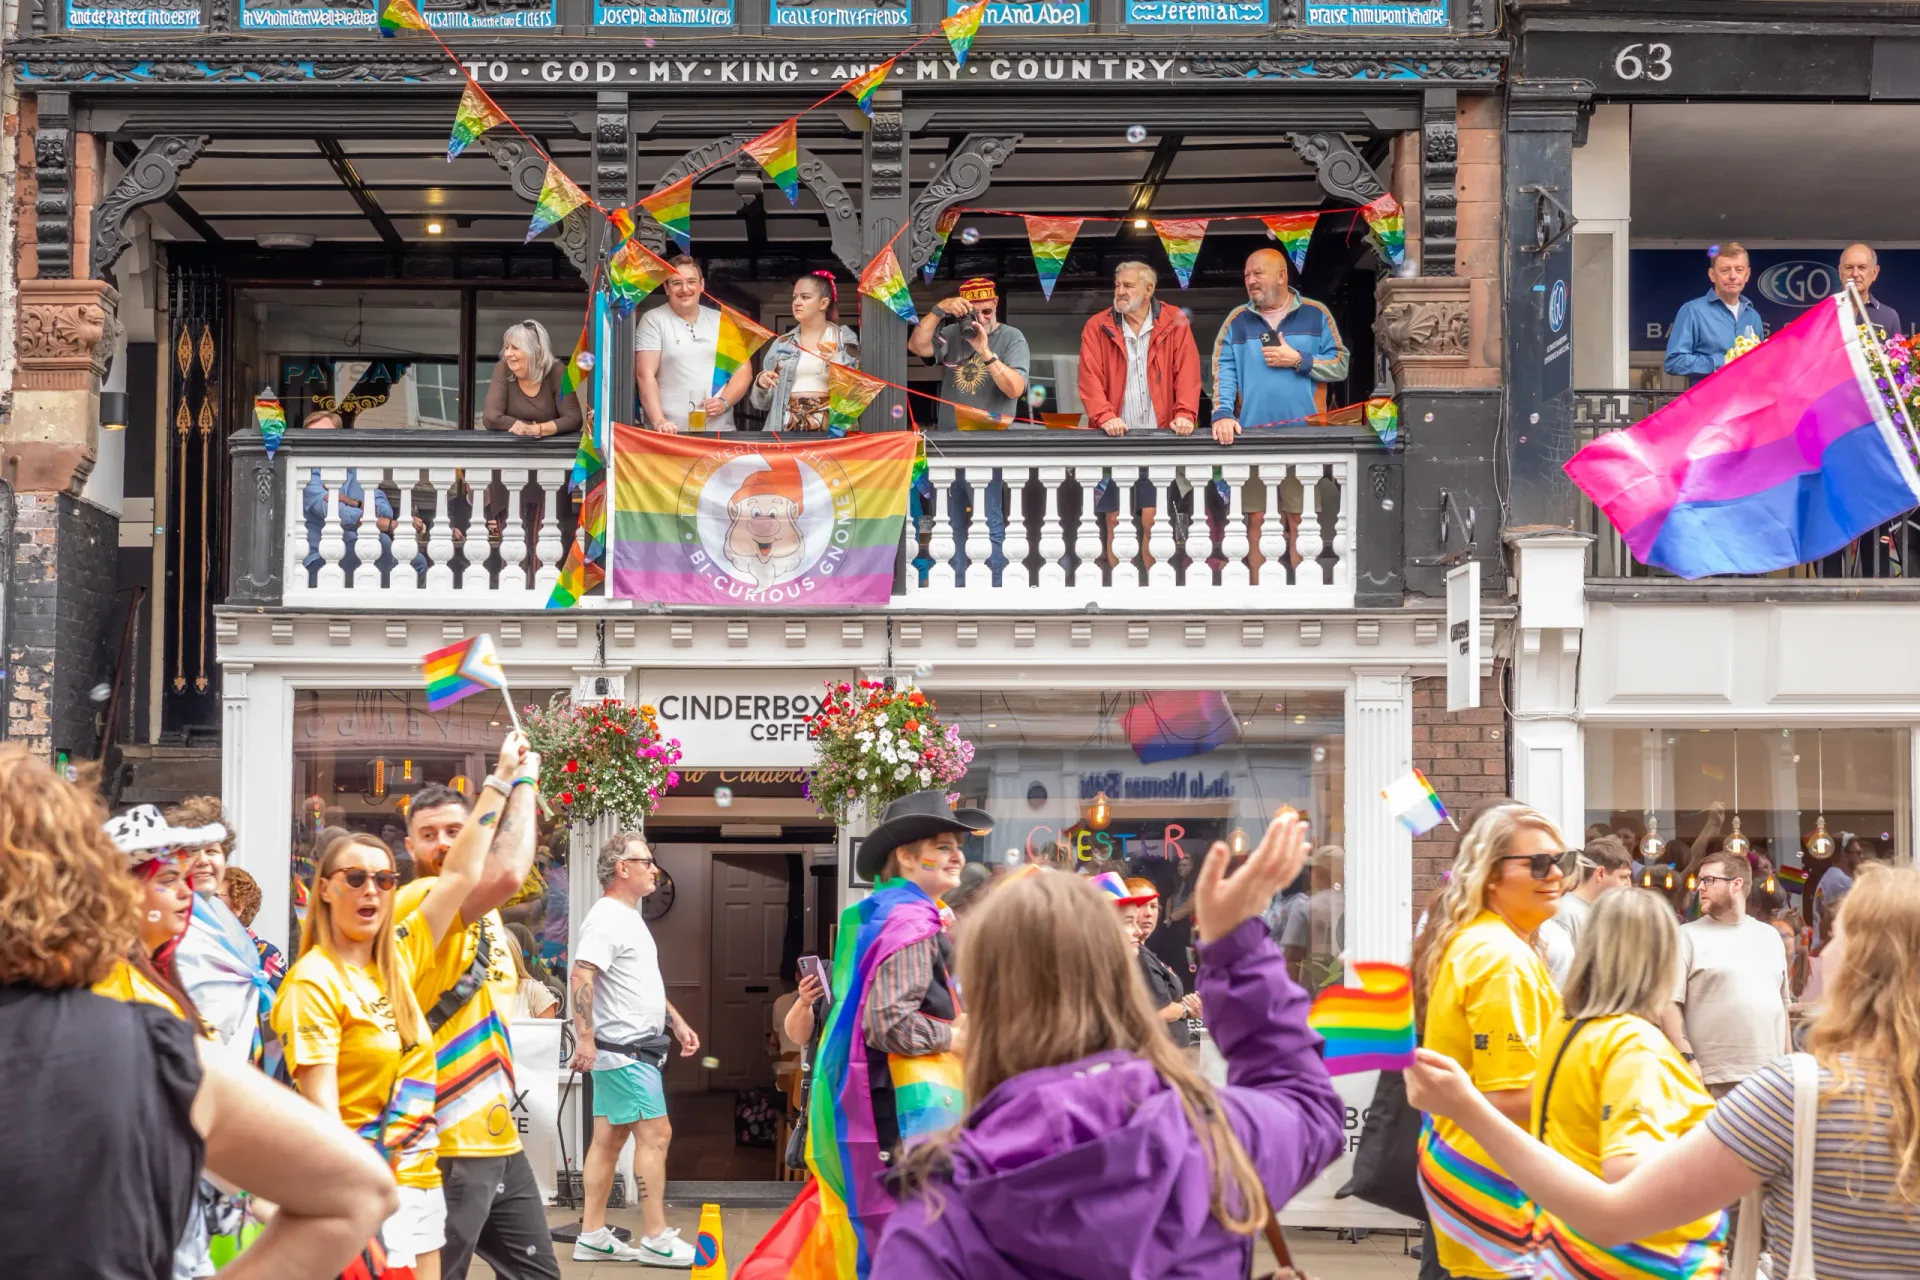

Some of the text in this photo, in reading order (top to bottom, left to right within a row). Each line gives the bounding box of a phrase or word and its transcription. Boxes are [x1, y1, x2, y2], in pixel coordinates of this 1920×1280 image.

[599, 8, 647, 25] Joseph
[1157, 4, 1239, 20] Jeremiah
[461, 61, 508, 81] TO
[541, 61, 616, 82] GOD
[650, 61, 699, 82] MY
[720, 61, 799, 82] KING
[917, 60, 961, 80] MY
[989, 59, 1174, 80] COUNTRY
[1615, 43, 1672, 81] 63
[1771, 265, 1832, 302] EGO
[693, 443, 759, 480] CAVERN
[690, 494, 851, 603] BI-CURIOUS GNOME
[659, 694, 828, 721] CINDERBOX
[750, 723, 818, 742] COFFE
[1025, 823, 1186, 865] CHESTER
